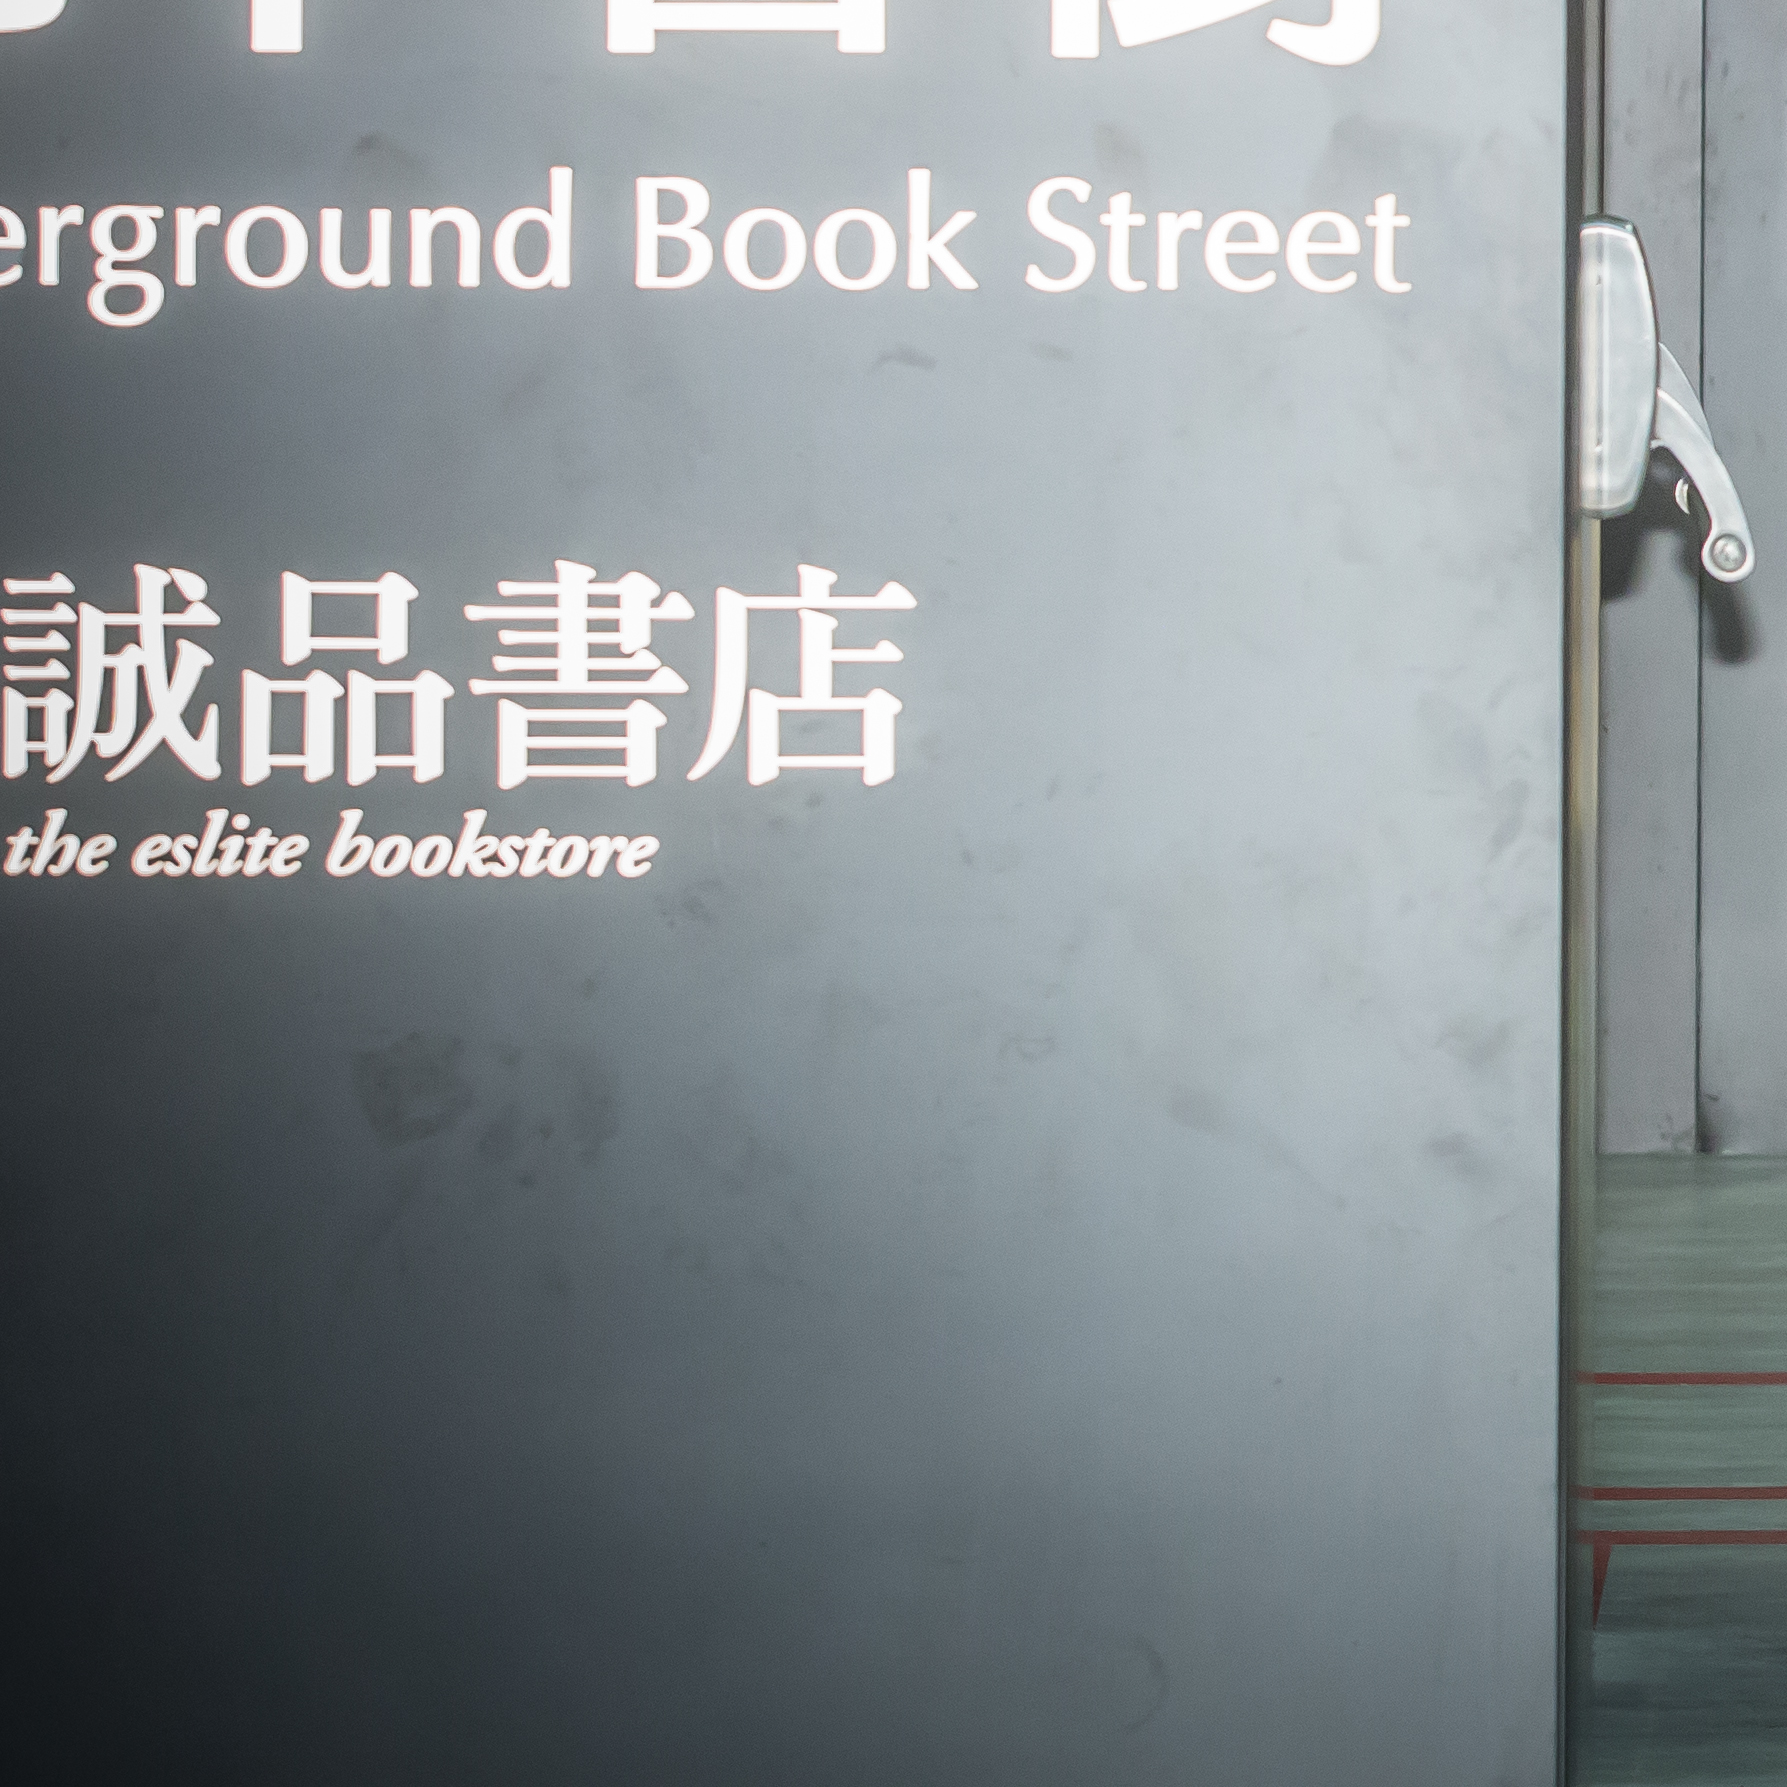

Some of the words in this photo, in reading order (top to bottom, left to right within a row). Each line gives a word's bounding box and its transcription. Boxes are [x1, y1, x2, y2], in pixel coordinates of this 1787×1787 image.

[634, 167, 979, 292] Book
[1024, 175, 1412, 295] Street
[1, 558, 919, 790] 誠品書店
[4, 808, 117, 877] the
[131, 808, 310, 878] eslite
[325, 808, 660, 878] bookstore
